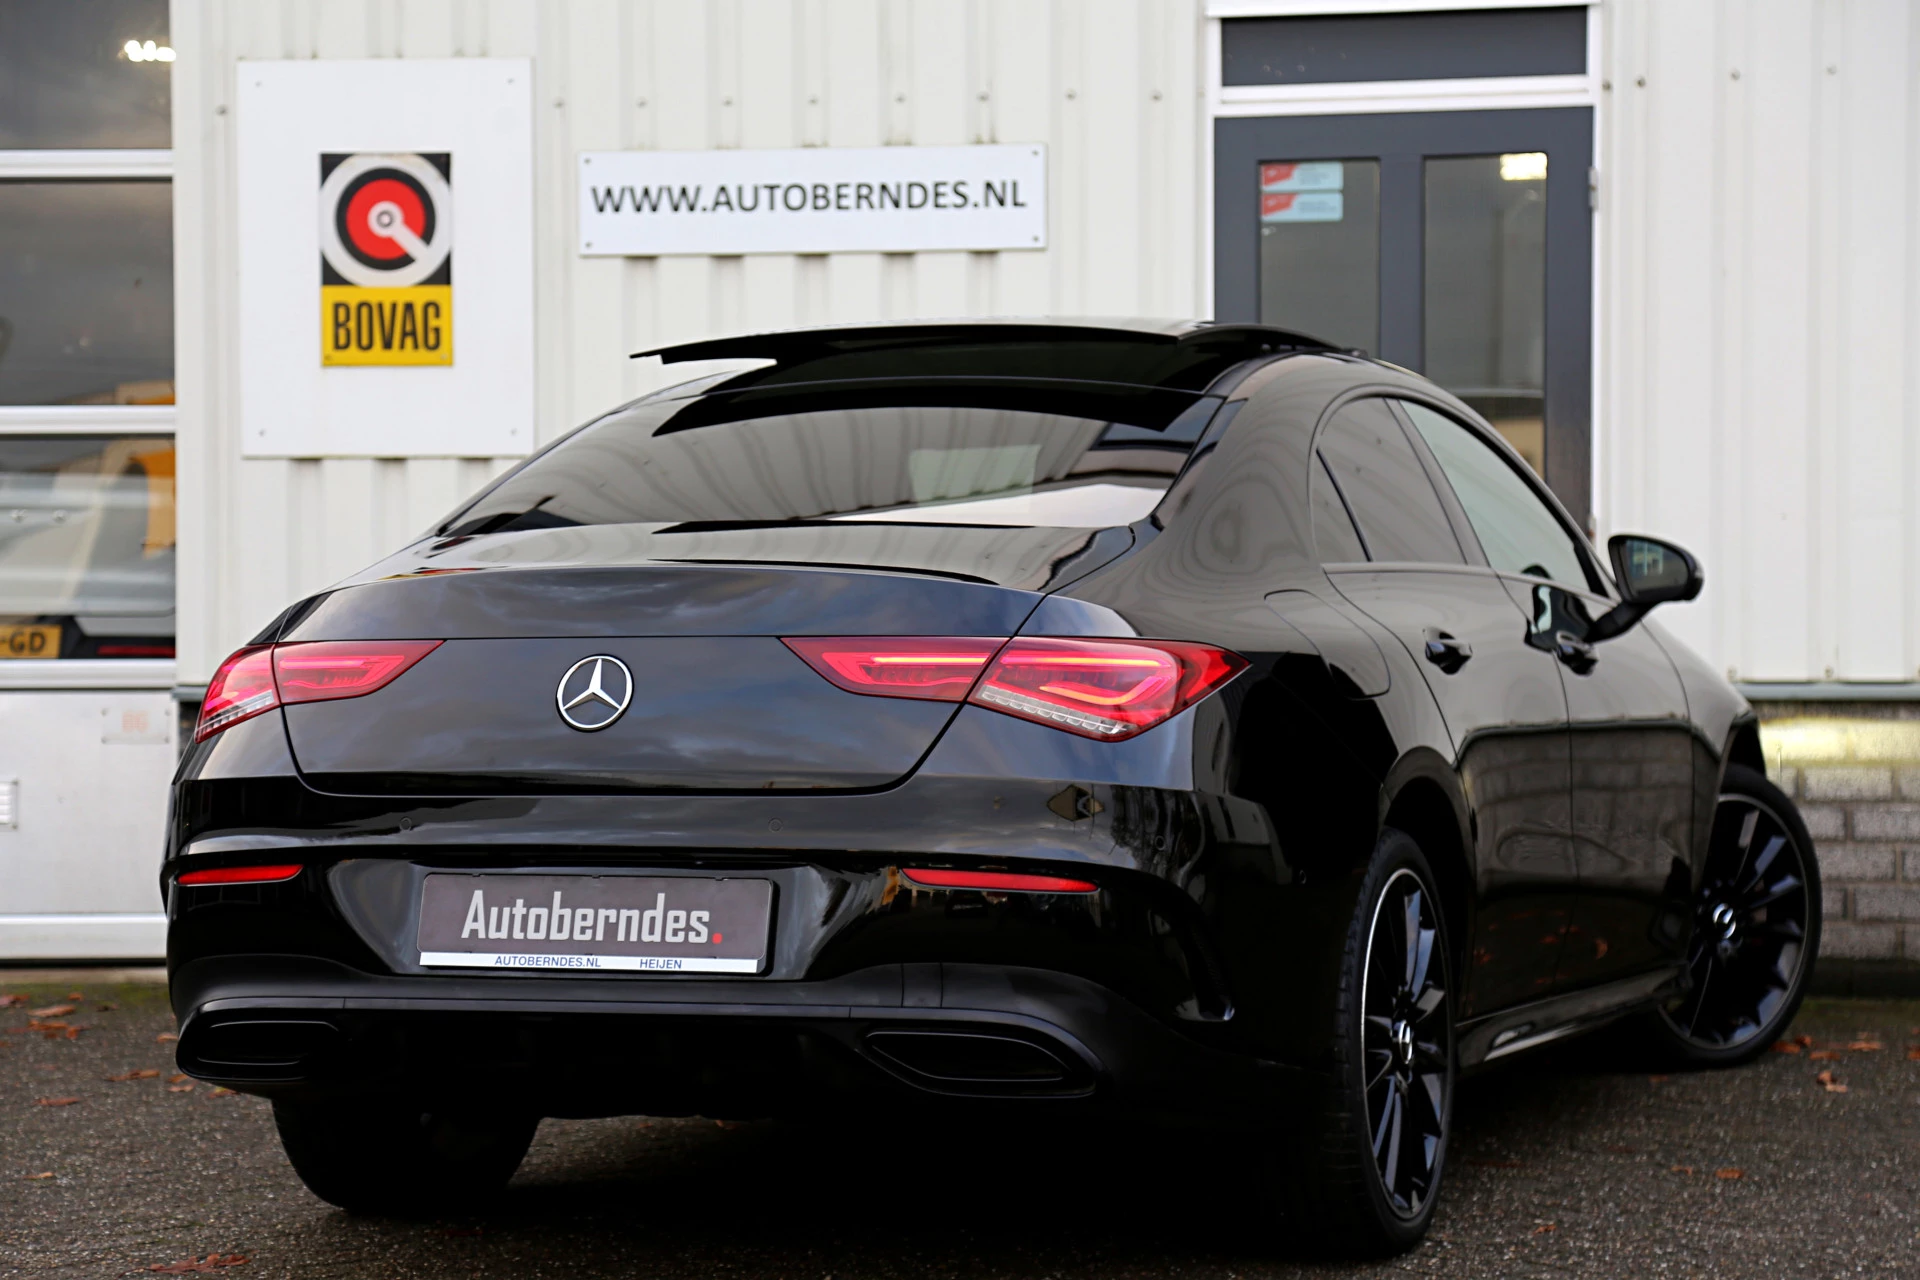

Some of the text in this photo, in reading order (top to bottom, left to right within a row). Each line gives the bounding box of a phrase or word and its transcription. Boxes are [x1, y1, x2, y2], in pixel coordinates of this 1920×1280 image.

[591, 180, 1026, 213] WWW.AUTOBERNDES.NL
[332, 301, 441, 351] BOVAG
[494, 955, 682, 970] AUTOBERNDES.NL HEIJEN
